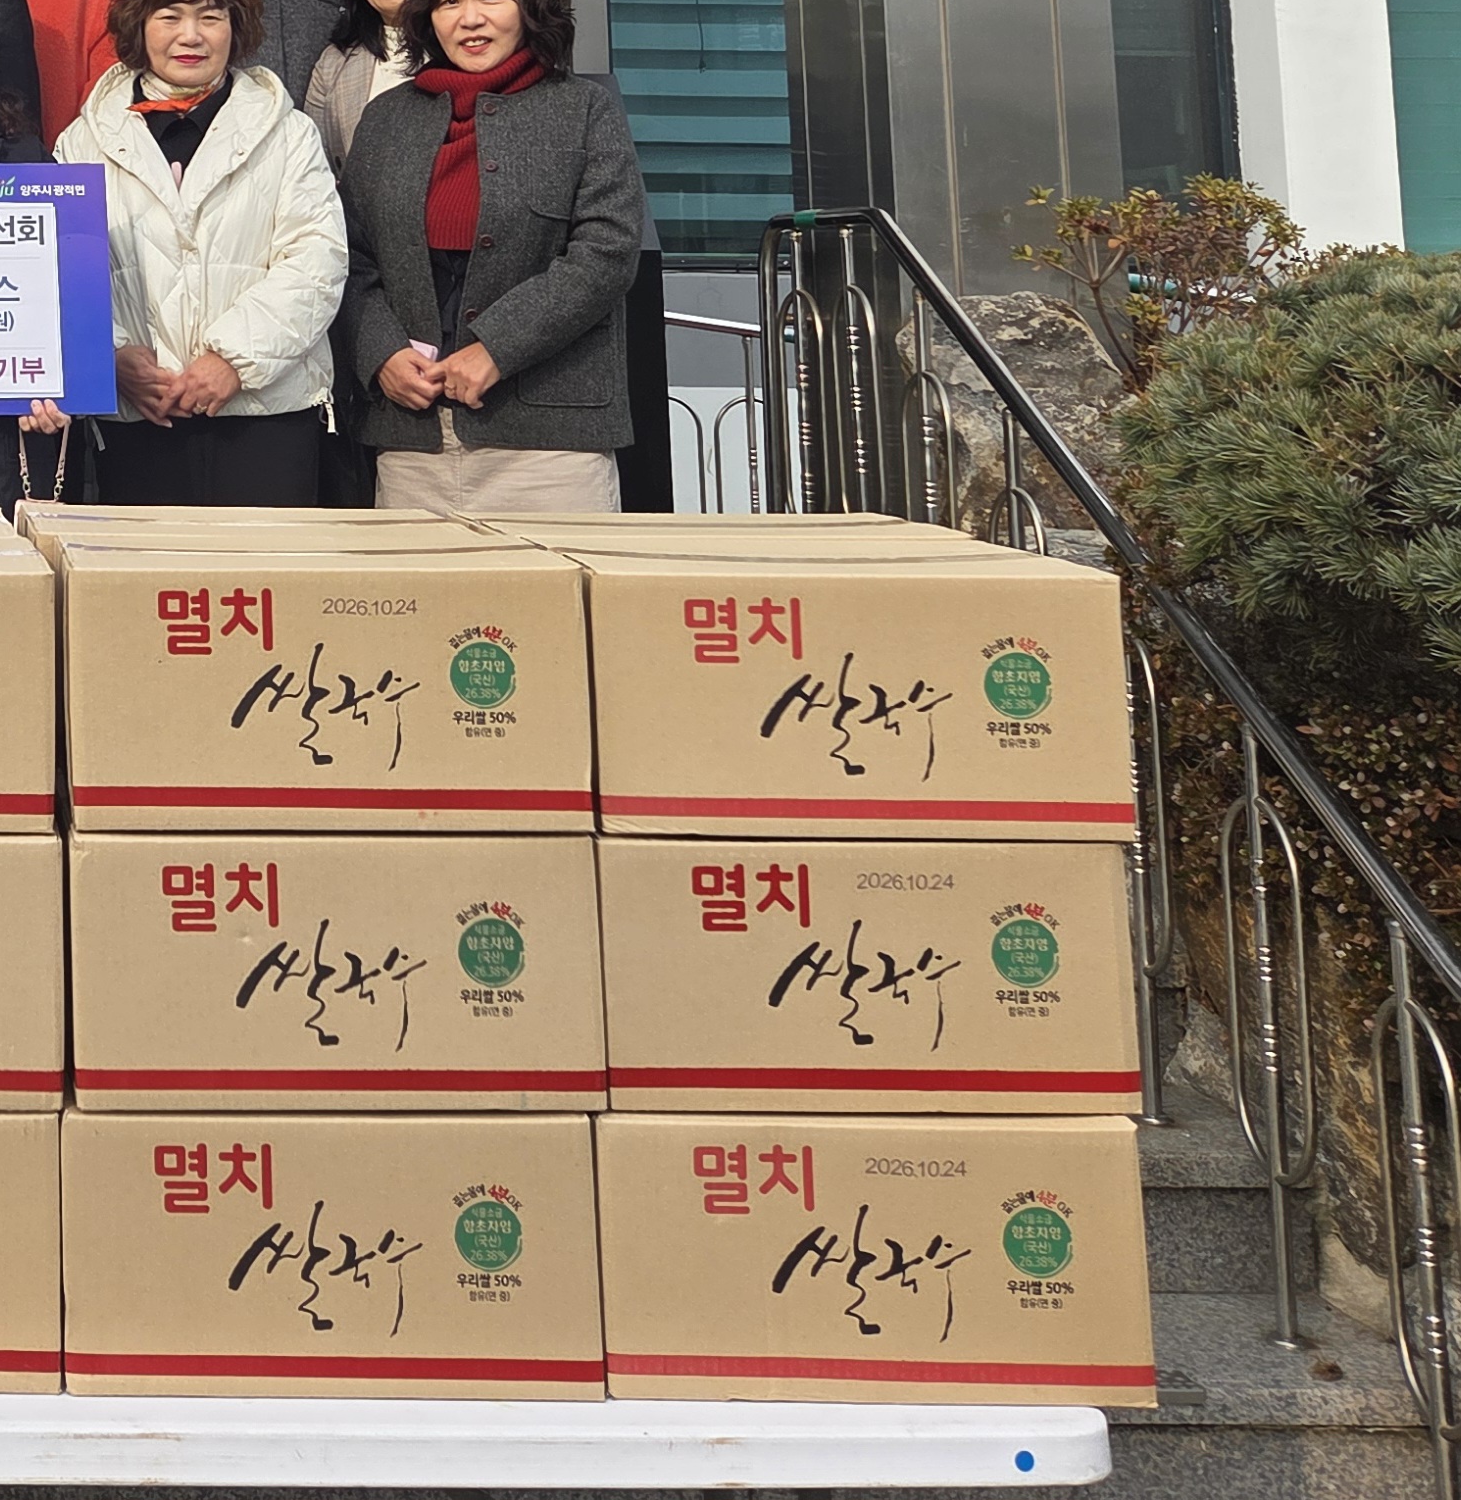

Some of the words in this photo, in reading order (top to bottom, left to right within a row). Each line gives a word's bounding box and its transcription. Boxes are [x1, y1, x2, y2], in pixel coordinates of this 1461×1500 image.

[158, 588, 274, 655] 멸치
[322, 598, 417, 616] 2026.10.24
[684, 597, 803, 664] 멸치
[232, 643, 420, 769] 쌀국수
[452, 711, 486, 726] 우리쌀
[489, 711, 515, 724] 50%
[761, 653, 952, 775] 쌀국수
[986, 722, 1021, 736] 우리쌀
[1024, 722, 1051, 735] 50%
[162, 863, 279, 932] 멸치
[692, 864, 810, 932] 멸치
[857, 873, 954, 891] 2026.10.24
[237, 919, 426, 1049] 쌀국수
[460, 990, 494, 1005] 우리쌀
[497, 990, 524, 1003] 50%
[769, 920, 960, 1049] 쌀국수
[995, 990, 1030, 1005] 우리쌀
[1033, 990, 1059, 1003] 50%
[154, 1144, 273, 1213] 멸치
[694, 1145, 815, 1214] 멸치
[865, 1158, 967, 1177] 2026.10.24
[229, 1201, 422, 1335] 쌀국수
[456, 1274, 491, 1289] 우리쌀
[494, 1274, 521, 1288] 50%
[773, 1205, 971, 1340] 쌀국수
[1007, 1280, 1043, 1296] 우리쌀
[1046, 1282, 1073, 1295] 50%
